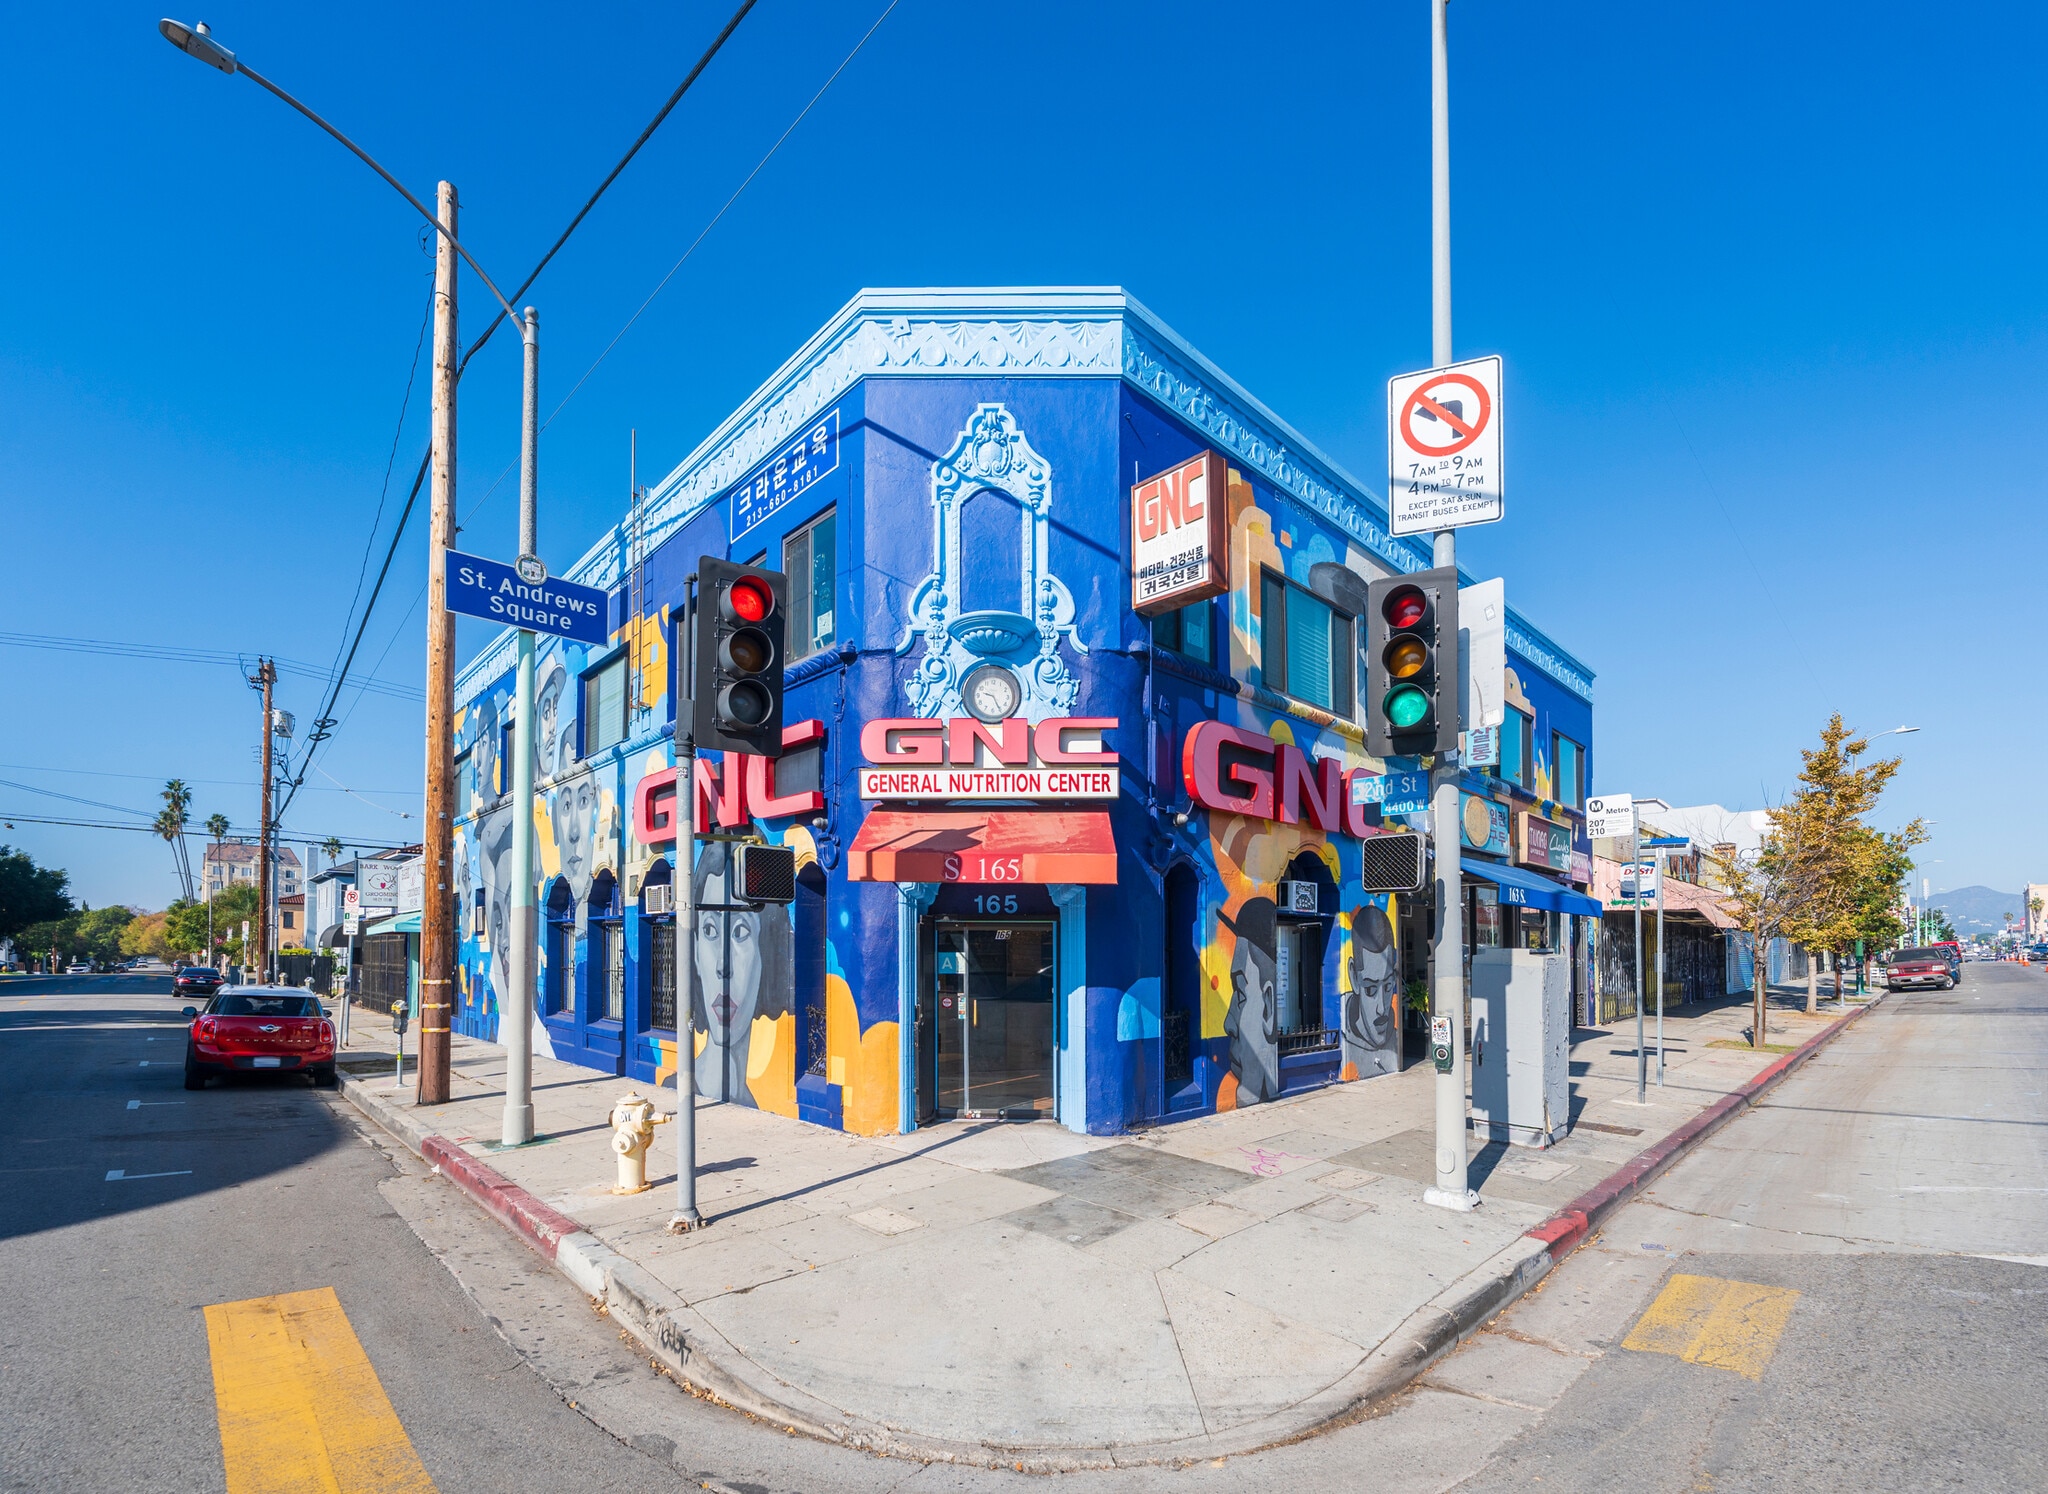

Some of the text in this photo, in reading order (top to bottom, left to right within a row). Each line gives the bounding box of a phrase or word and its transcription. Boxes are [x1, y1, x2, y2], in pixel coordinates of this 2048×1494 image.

[739, 426, 827, 515] 크라운교육
[1440, 461, 1449, 470] TO
[1441, 478, 1451, 488] TO
[746, 465, 818, 527] 213-660-8181
[1138, 460, 1204, 543] GNC
[1408, 492, 1482, 511] EXCEPT SAT & SUN
[1398, 500, 1494, 522] TRANSIT BUSES EXEMPT
[1144, 564, 1199, 595] 귀국선물
[459, 567, 493, 591] St.
[499, 577, 598, 617] Andrews
[489, 595, 572, 630] Square
[860, 717, 1120, 763] GNC
[634, 719, 824, 845] GNC
[867, 773, 1111, 793] GENERAL NUTRITION CENTER
[1183, 720, 1398, 839] GNC
[1365, 776, 1417, 798] 2nd St
[1385, 798, 1425, 813] 4400 W
[1589, 819, 1605, 828] 207
[1589, 828, 1605, 836] 210
[944, 857, 1020, 880] S. 165
[974, 894, 1018, 914] 165
[1509, 887, 1519, 902] 163
[995, 930, 1012, 940] 165
[942, 957, 953, 970] A
